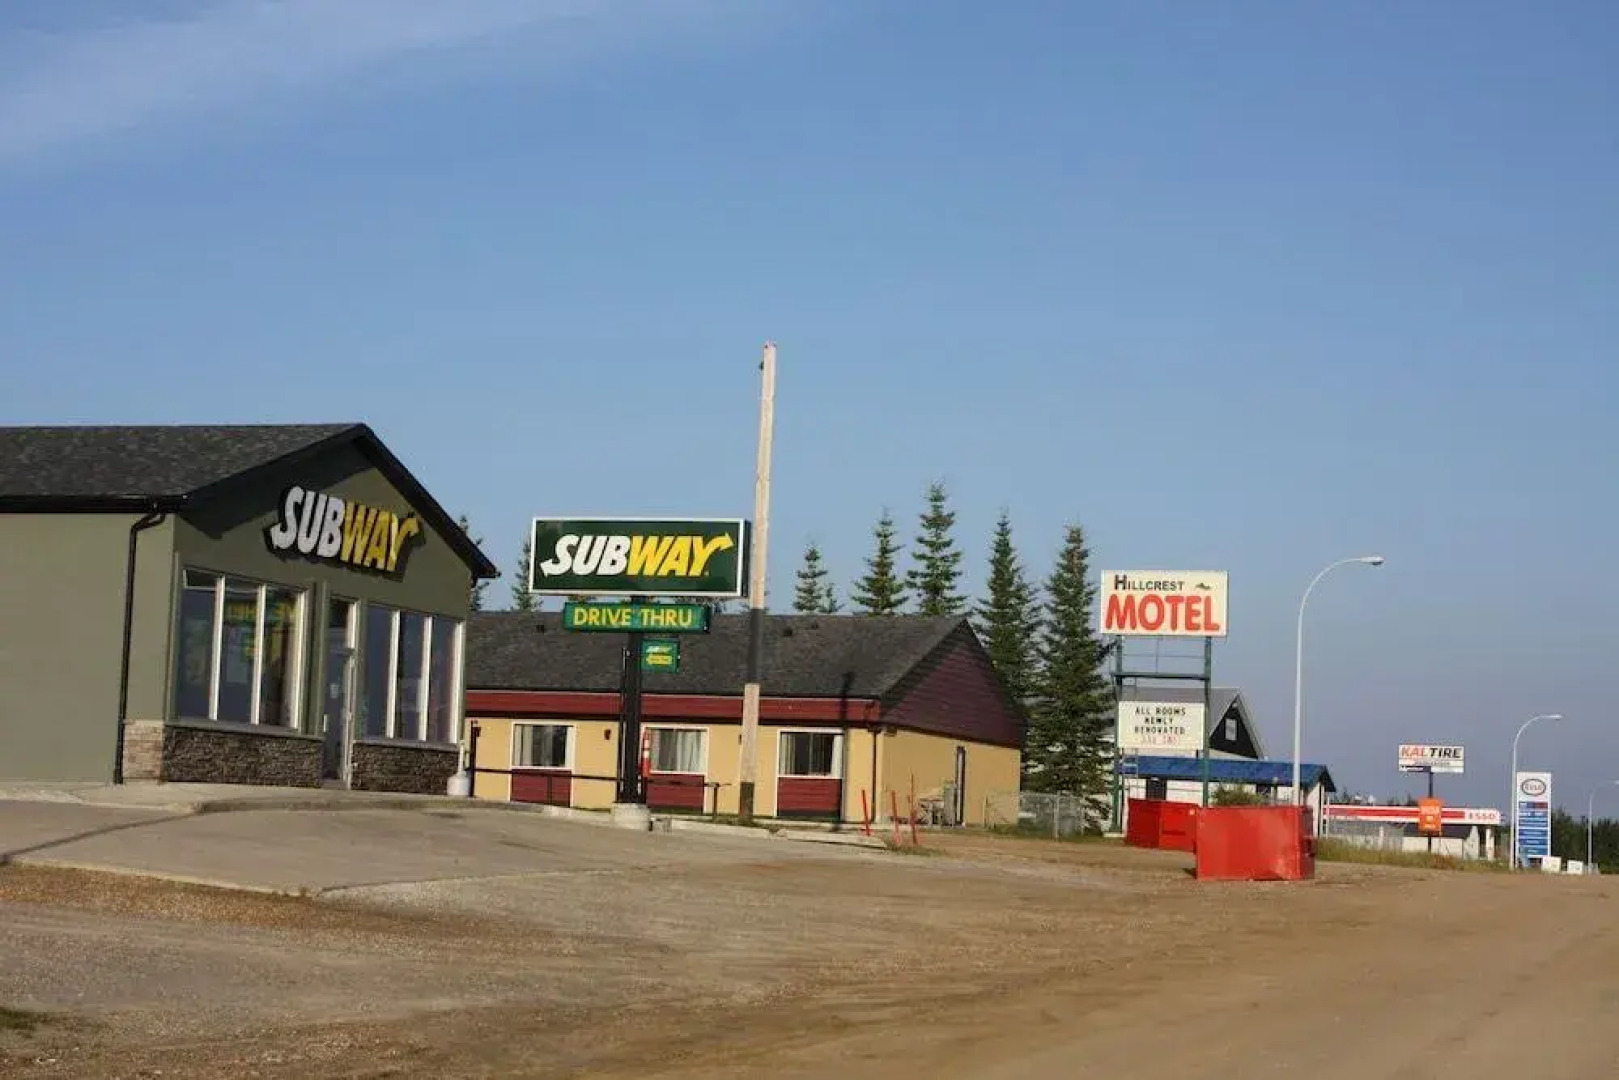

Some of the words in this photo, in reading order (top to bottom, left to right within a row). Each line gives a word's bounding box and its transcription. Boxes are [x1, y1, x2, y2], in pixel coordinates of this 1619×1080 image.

[269, 485, 420, 571] SUBWAY
[540, 533, 734, 577] SUBWAY
[1114, 574, 1185, 590] HILLCREST
[573, 608, 631, 626] DRIVE
[640, 609, 693, 628] THRU
[1105, 593, 1220, 631] MOTEL
[1135, 707, 1151, 715] ALL
[1155, 706, 1186, 716] ROOMS
[1429, 747, 1462, 759] TIRE
